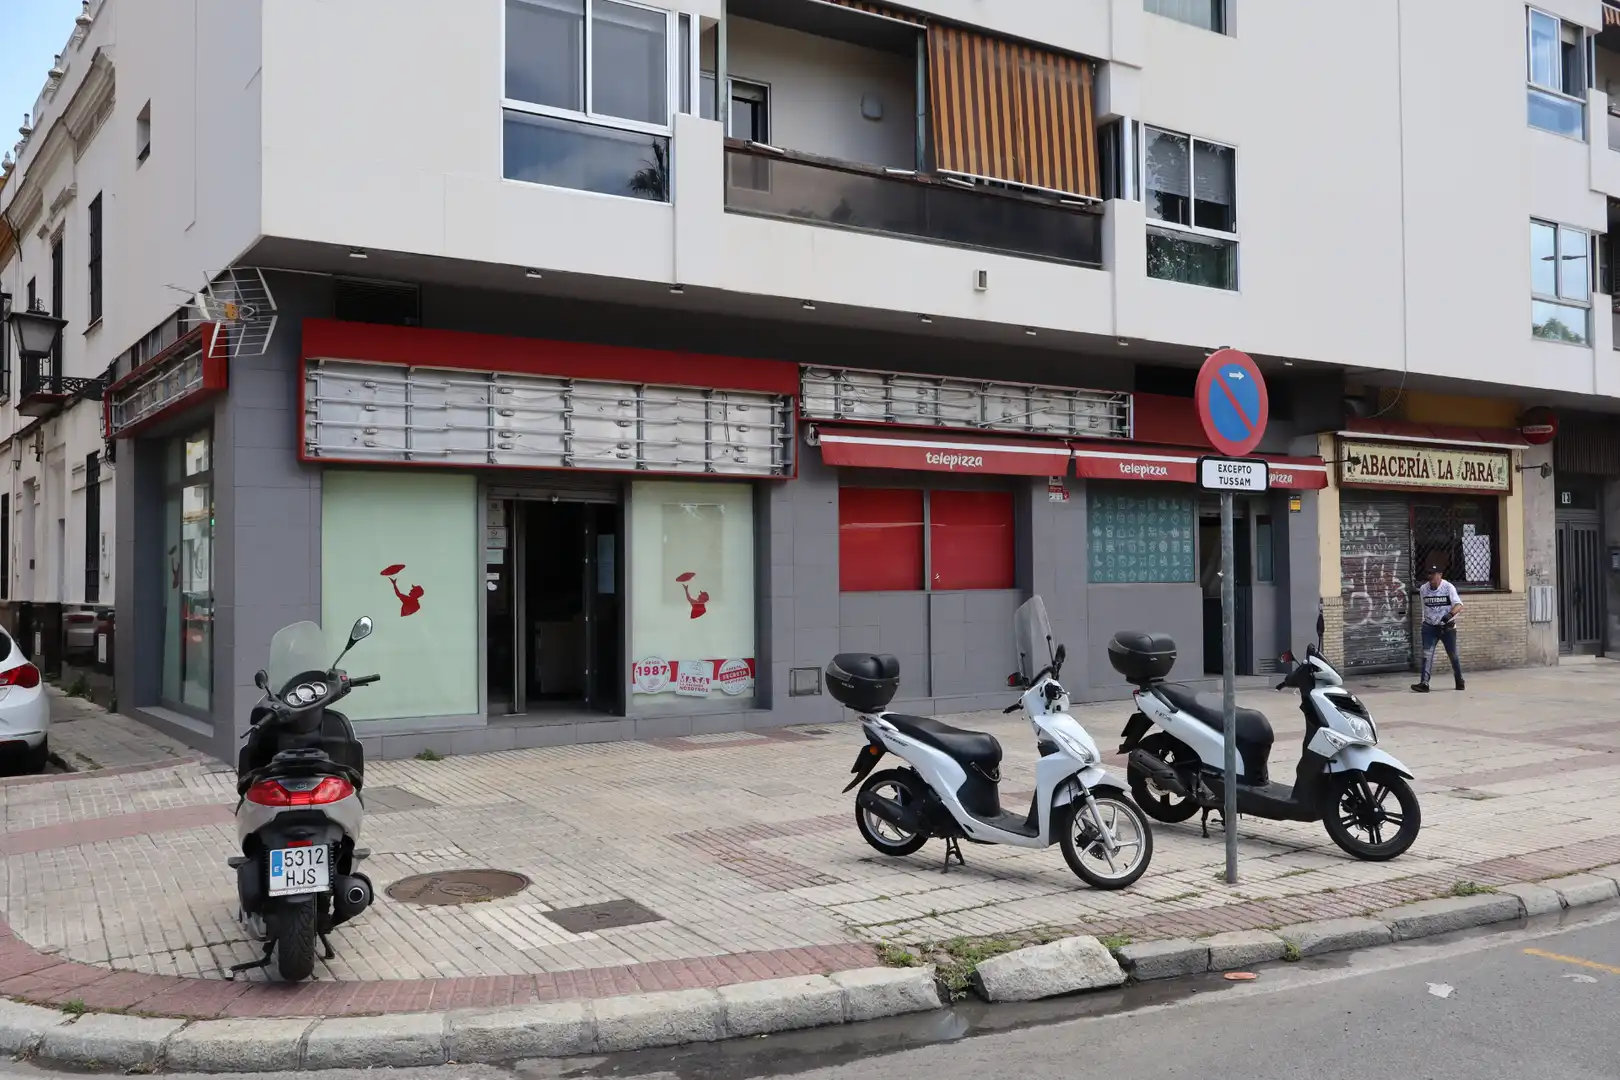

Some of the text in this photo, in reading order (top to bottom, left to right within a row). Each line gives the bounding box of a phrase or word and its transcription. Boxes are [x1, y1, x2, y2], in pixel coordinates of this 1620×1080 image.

[926, 452, 983, 469] telepizza
[1360, 452, 1429, 479] ABACERÍA
[1437, 459, 1454, 480] LA
[1120, 463, 1168, 478] telepizza
[1218, 464, 1252, 474] EXCEPTO
[1219, 477, 1251, 486] TUSSAM
[1268, 472, 1293, 486] pizza
[637, 665, 668, 676] 1987
[284, 847, 324, 867] 5312
[286, 868, 316, 887] HJS
